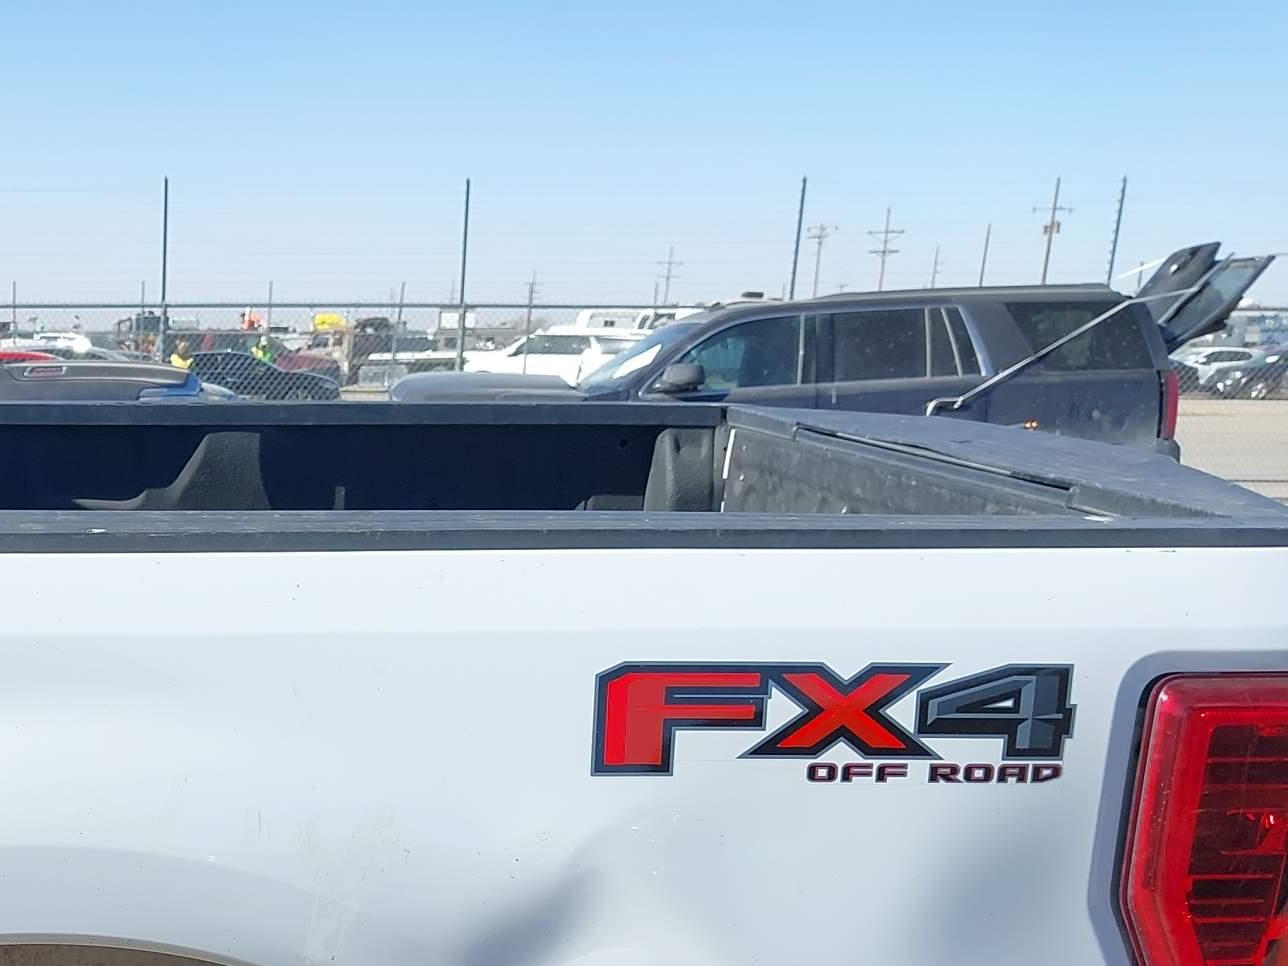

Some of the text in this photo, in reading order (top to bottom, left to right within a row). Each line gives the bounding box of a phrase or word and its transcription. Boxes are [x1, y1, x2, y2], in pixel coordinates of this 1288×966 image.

[591, 661, 1077, 776] FX4
[806, 763, 1063, 784] OFF ROAD
